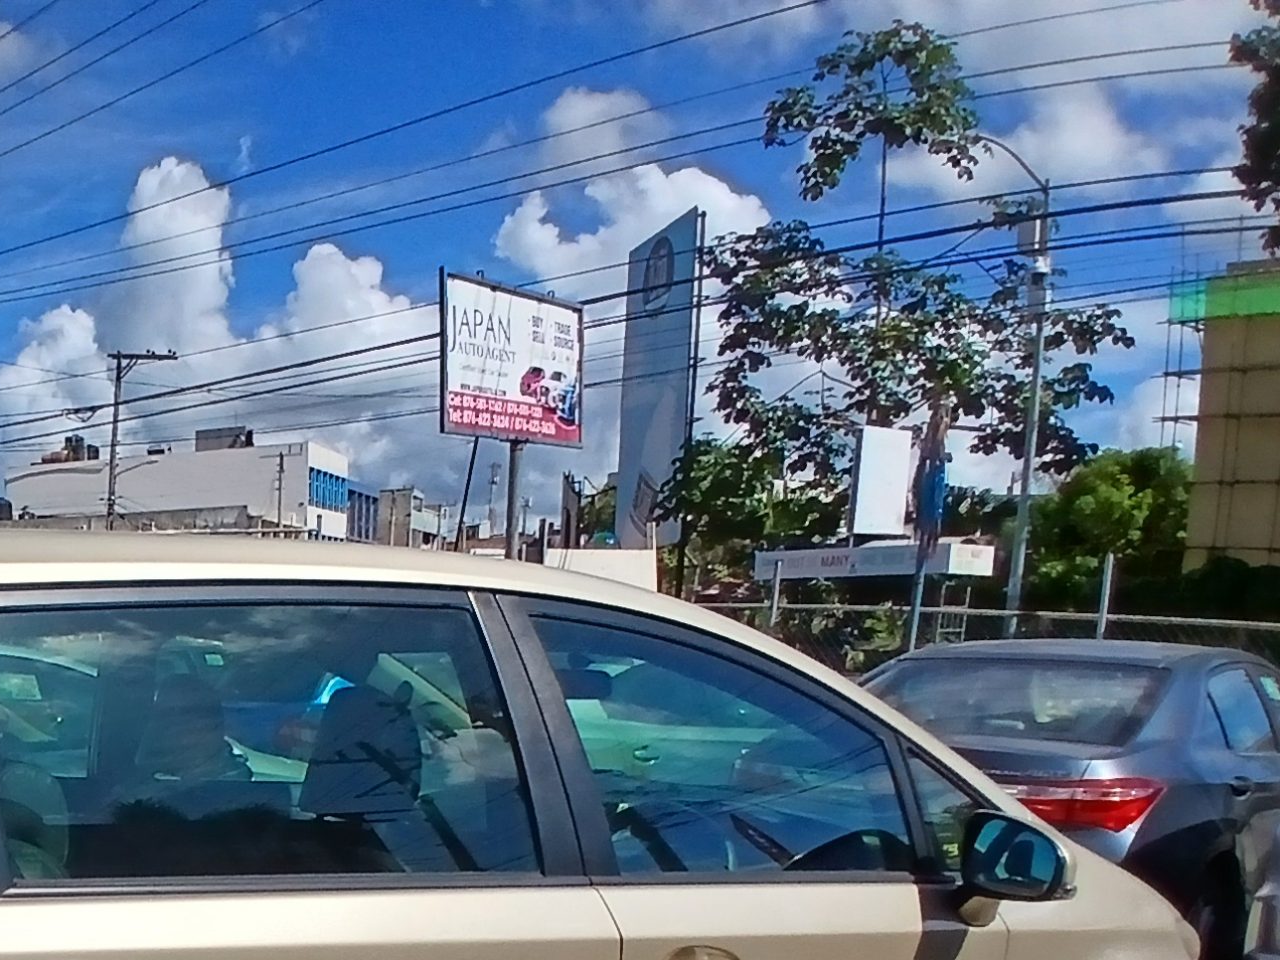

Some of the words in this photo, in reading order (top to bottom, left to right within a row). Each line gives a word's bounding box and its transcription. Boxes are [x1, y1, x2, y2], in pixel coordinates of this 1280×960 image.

[449, 304, 511, 353] JAPAN
[531, 315, 544, 329] BUY
[554, 321, 571, 337] TRADE
[531, 330, 545, 344] SELL
[457, 341, 484, 358] AUTO
[485, 346, 517, 364] AGENT
